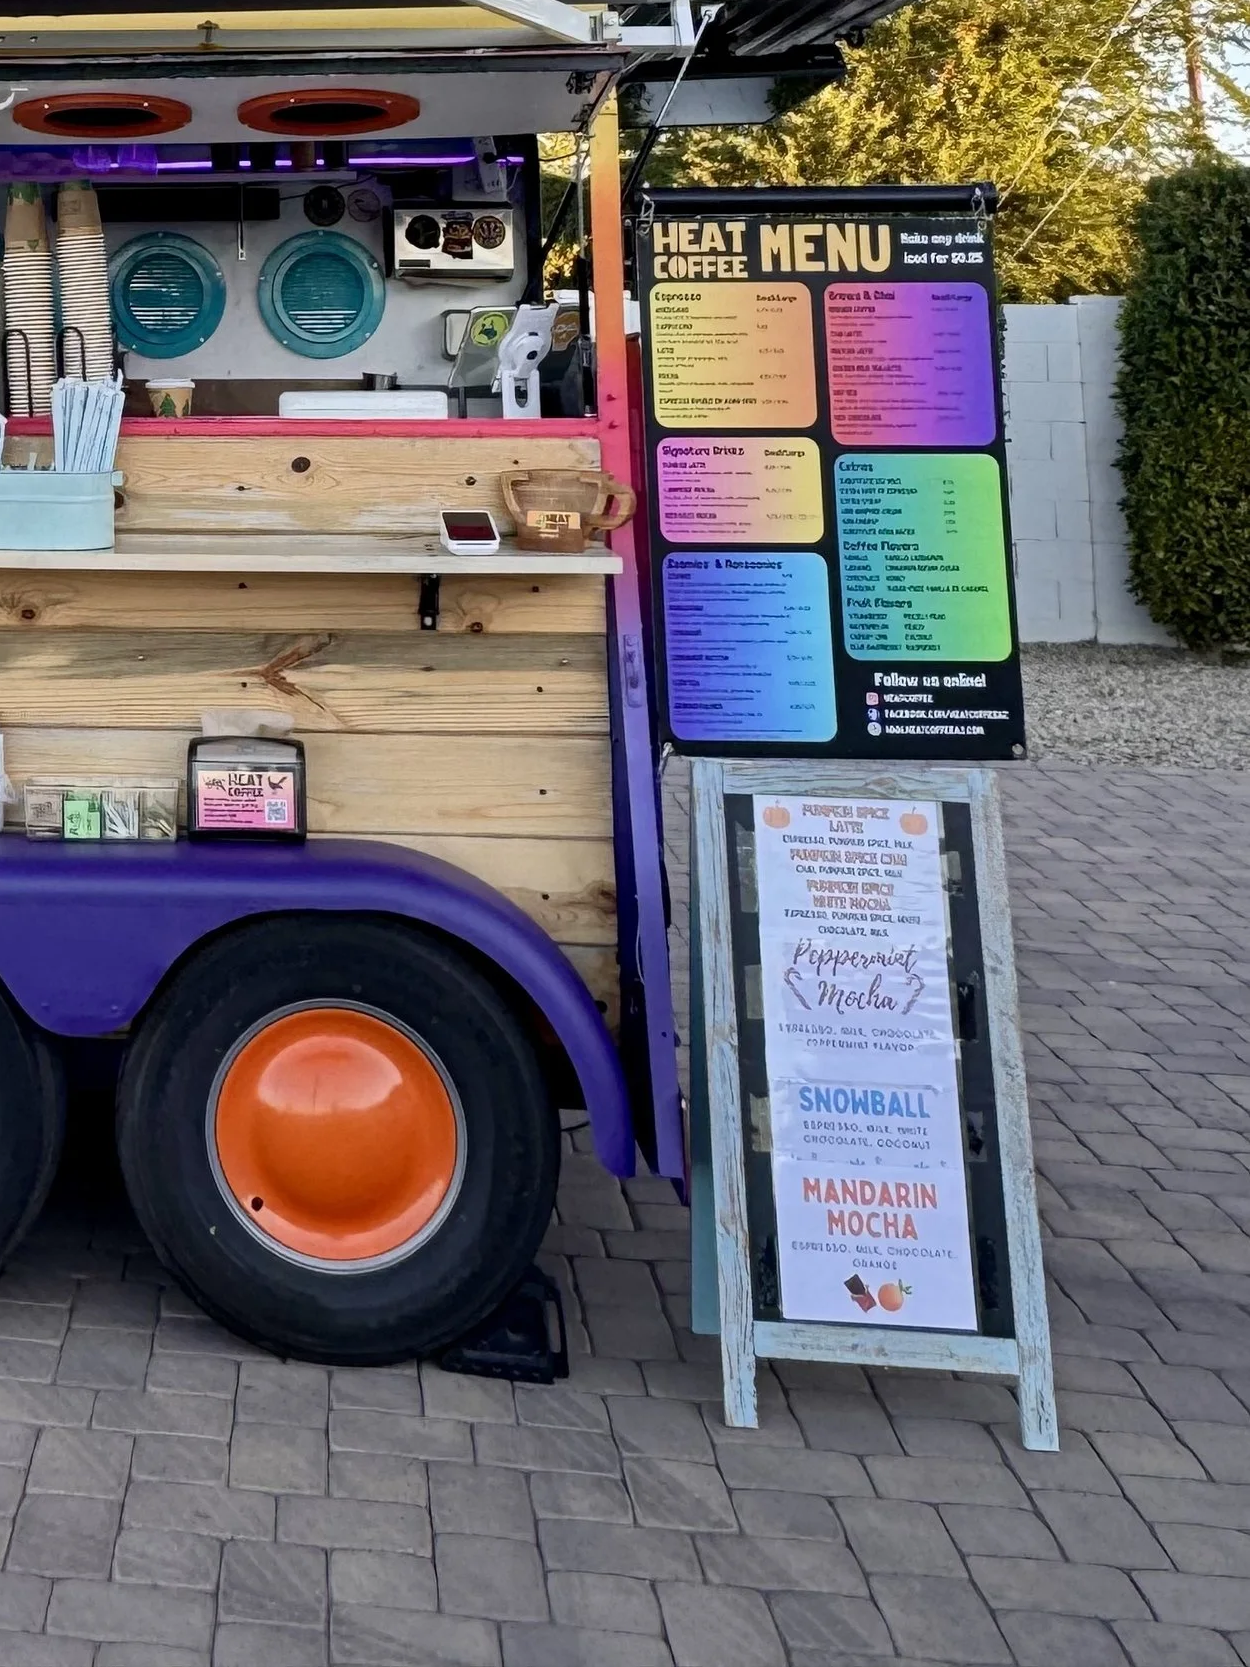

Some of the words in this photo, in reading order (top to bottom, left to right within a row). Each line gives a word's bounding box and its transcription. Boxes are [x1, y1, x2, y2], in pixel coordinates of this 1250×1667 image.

[652, 221, 747, 254] HEAT
[760, 222, 892, 274] MENU
[653, 254, 749, 280] COFFEE
[873, 672, 919, 687] Follow
[793, 938, 919, 976] Peppermint
[818, 973, 898, 1015] Mocha
[800, 1085, 931, 1118] SNOWBALL
[803, 1177, 938, 1209] MANDARIN
[827, 1209, 919, 1241] MOCHA
